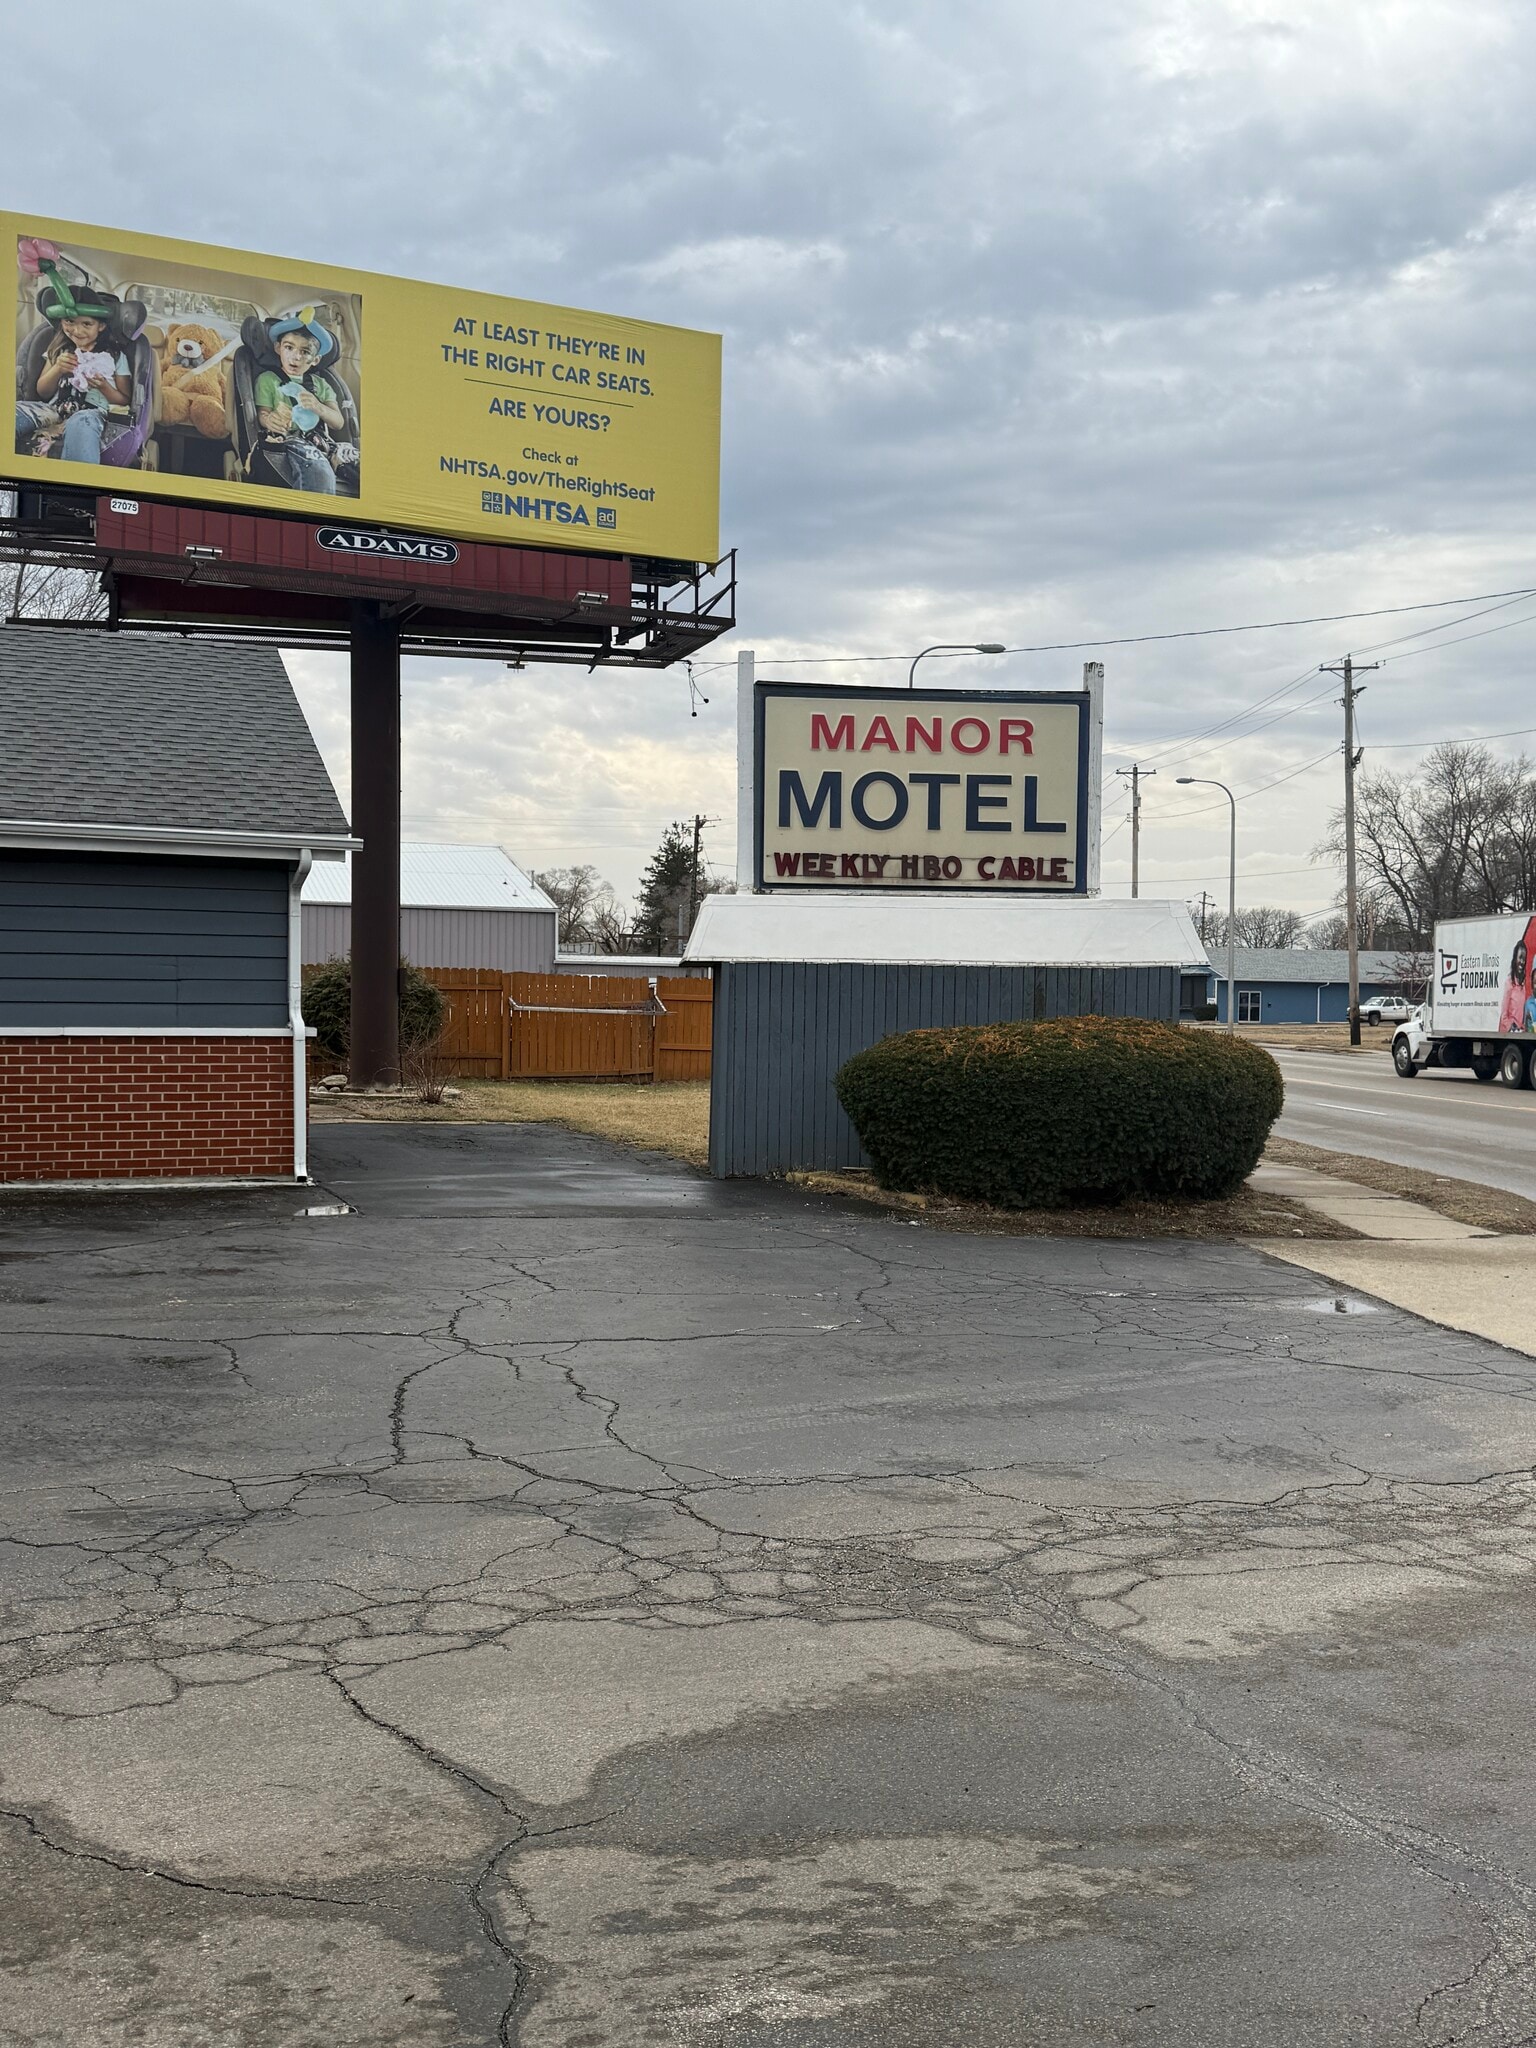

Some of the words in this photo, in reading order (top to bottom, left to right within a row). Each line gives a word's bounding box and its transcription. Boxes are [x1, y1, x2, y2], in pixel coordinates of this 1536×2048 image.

[453, 317, 477, 336] AT
[483, 322, 540, 347] LEAST
[545, 332, 620, 362] THEY'RE
[626, 347, 645, 366] IN
[440, 344, 479, 367] THE
[486, 352, 545, 378] RIGHT
[552, 364, 590, 386] CAR
[596, 371, 655, 397] SEATS.
[489, 397, 526, 419] ARE
[533, 403, 611, 432] YOURS?
[522, 447, 561, 464] Check
[565, 454, 579, 466] at
[440, 456, 655, 502] NHTSA.gov/TheRightSeat
[111, 500, 138, 512] 27075
[504, 494, 590, 526] NHTSA
[598, 510, 615, 523] ad
[328, 533, 449, 559] ADAMS
[811, 713, 1035, 755] MANOR
[778, 769, 1067, 834] MOTEL
[773, 852, 890, 879] WEEKLY
[901, 854, 963, 881] HBO
[976, 856, 1068, 882] CABLE
[1460, 954, 1481, 969] Eastern
[1481, 953, 1500, 968] Illinois
[1460, 970, 1499, 989] FOODBANK
